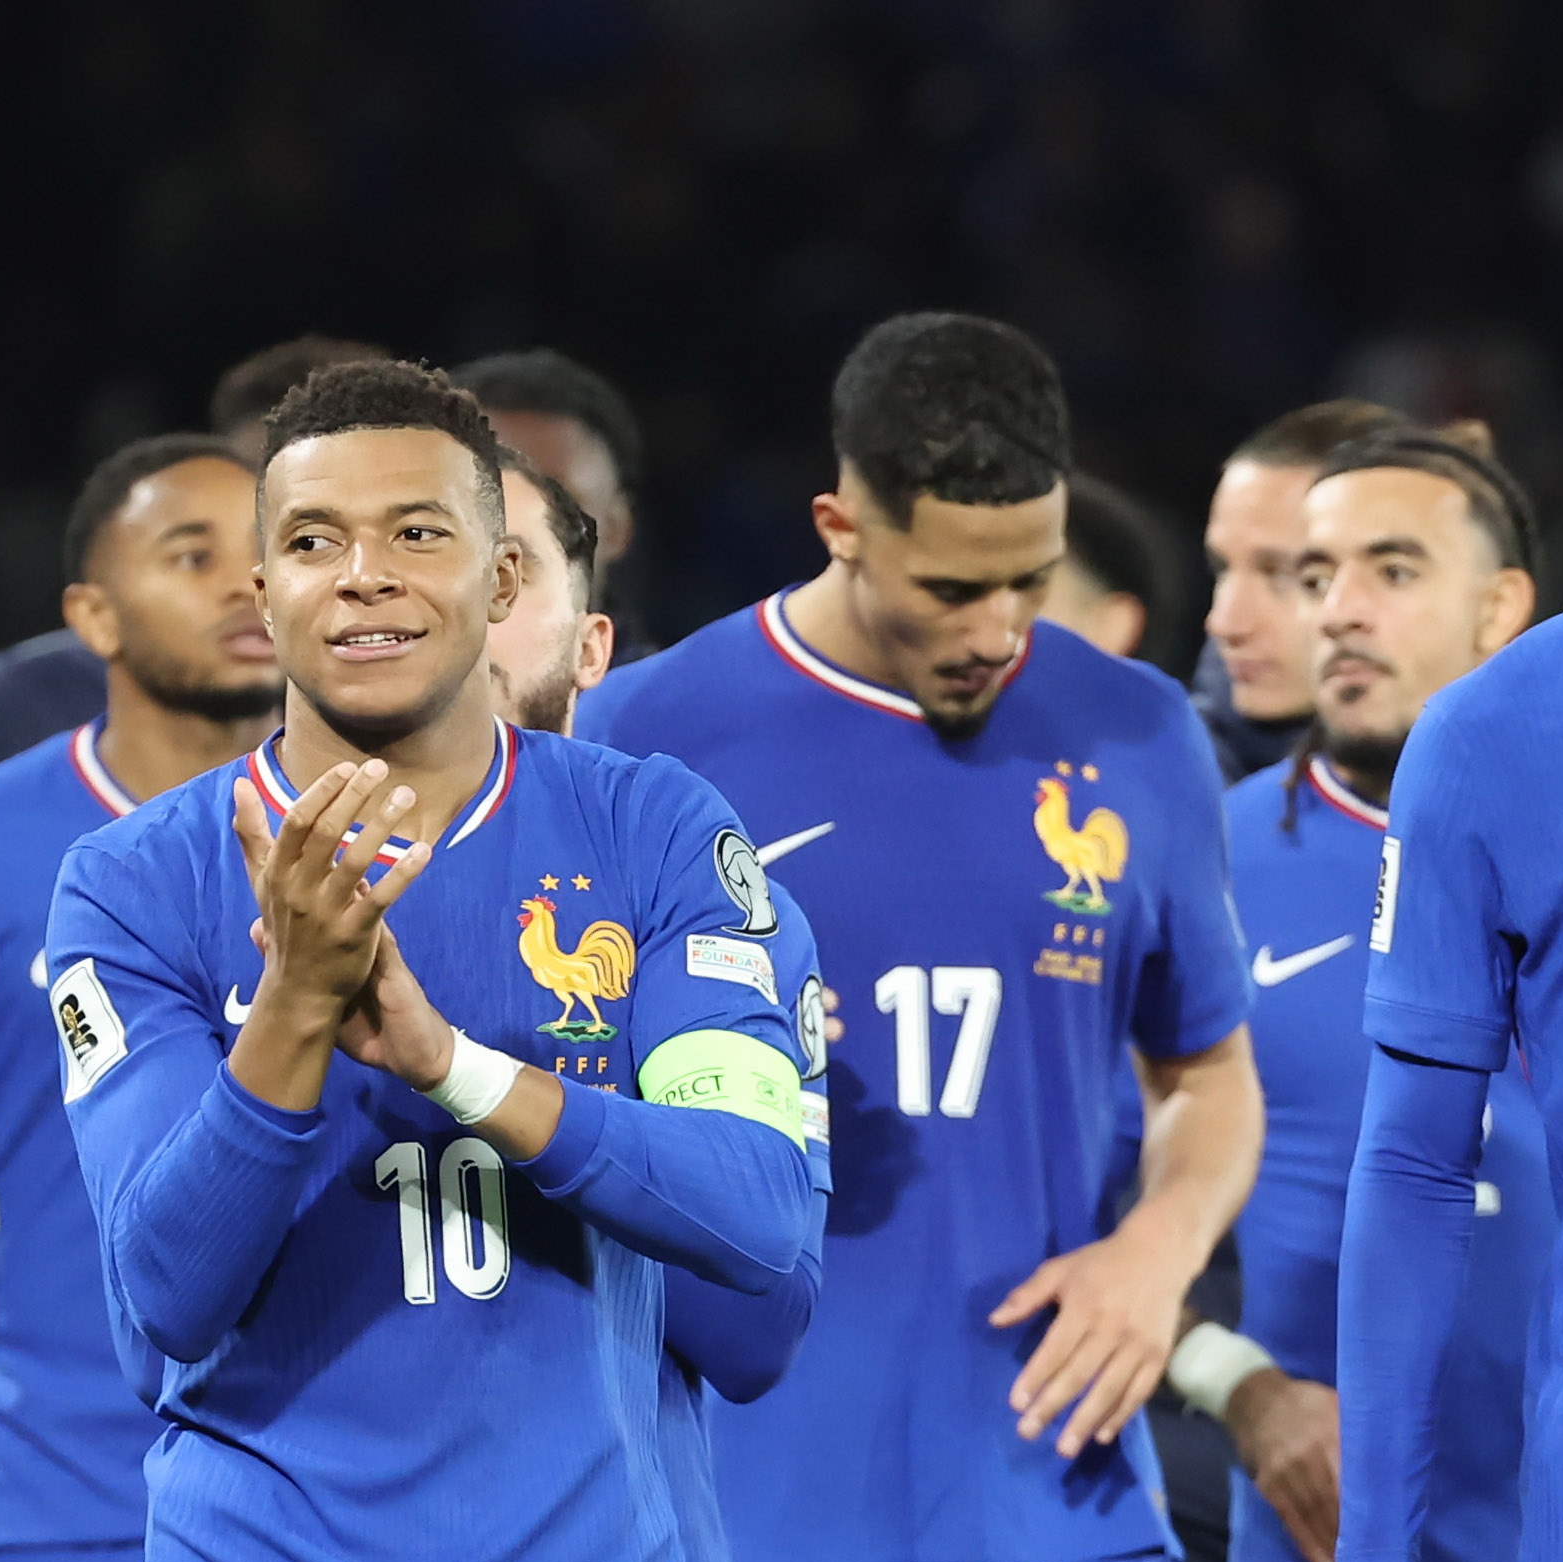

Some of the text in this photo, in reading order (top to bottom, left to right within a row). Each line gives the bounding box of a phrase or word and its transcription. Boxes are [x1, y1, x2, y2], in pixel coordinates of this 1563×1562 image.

[691, 937, 717, 946] UEFA
[874, 965, 1003, 1119] 17
[656, 1075, 724, 1107] PECT
[374, 1136, 511, 1305] 10
